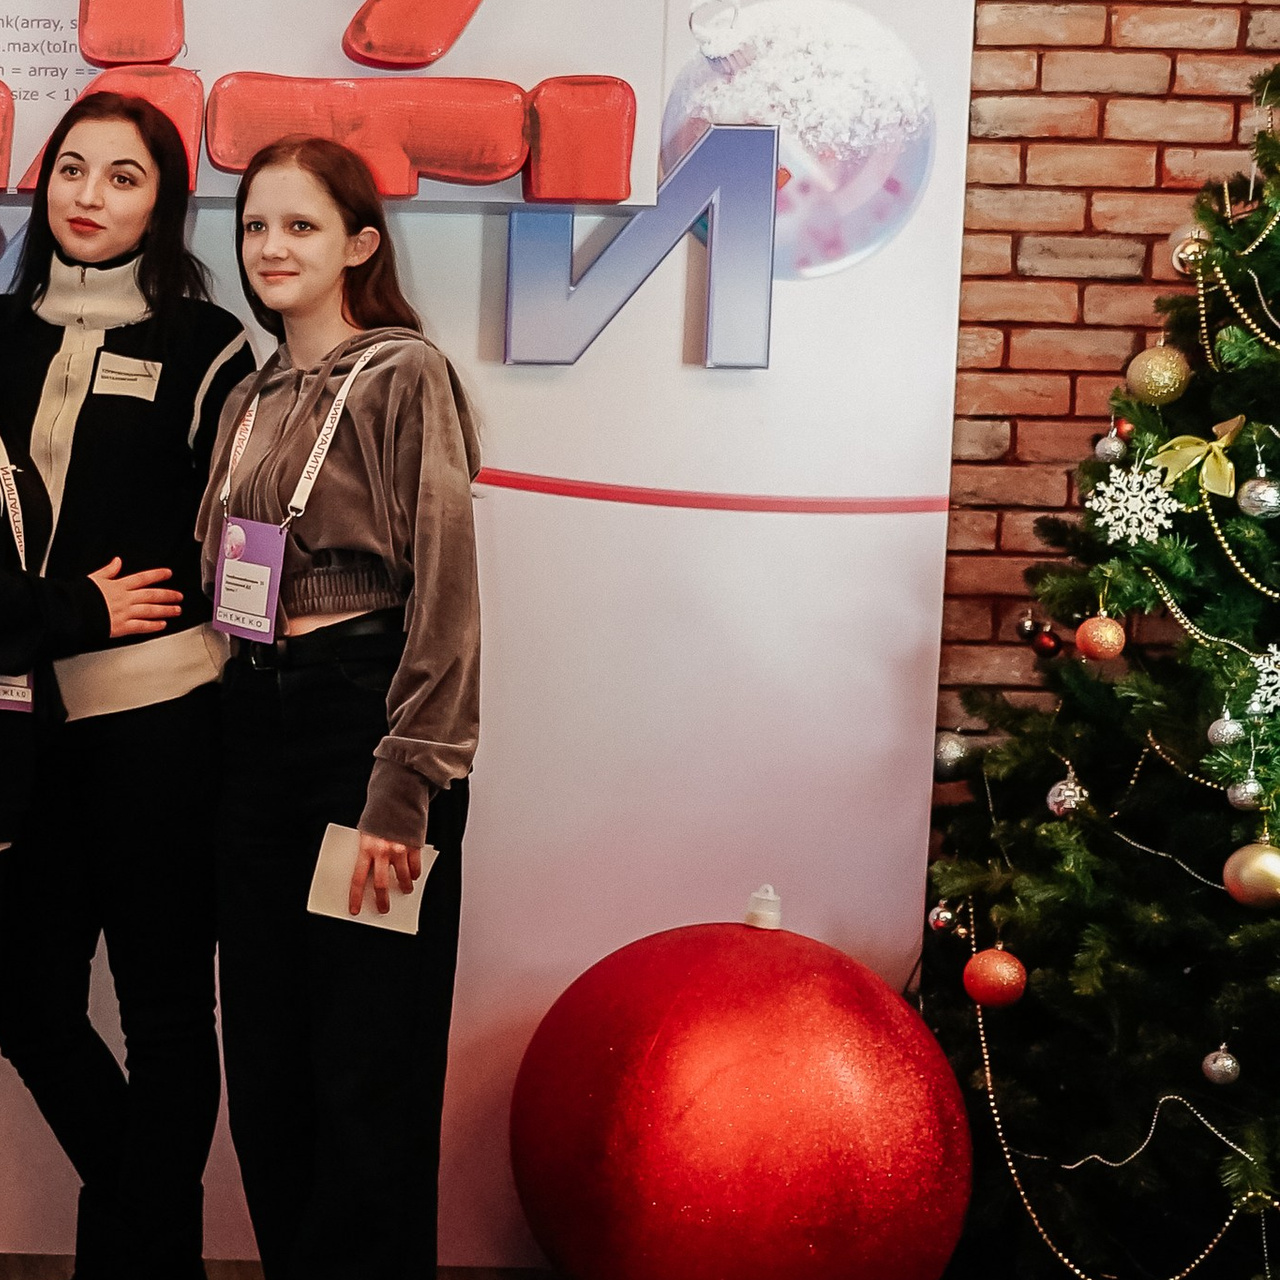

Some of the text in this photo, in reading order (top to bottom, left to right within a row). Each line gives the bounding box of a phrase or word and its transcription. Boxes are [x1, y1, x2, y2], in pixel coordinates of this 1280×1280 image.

[28, 66, 69, 80] array
[11, 88, 39, 101] size
[303, 397, 344, 482] ВИРТУАЛИТИ
